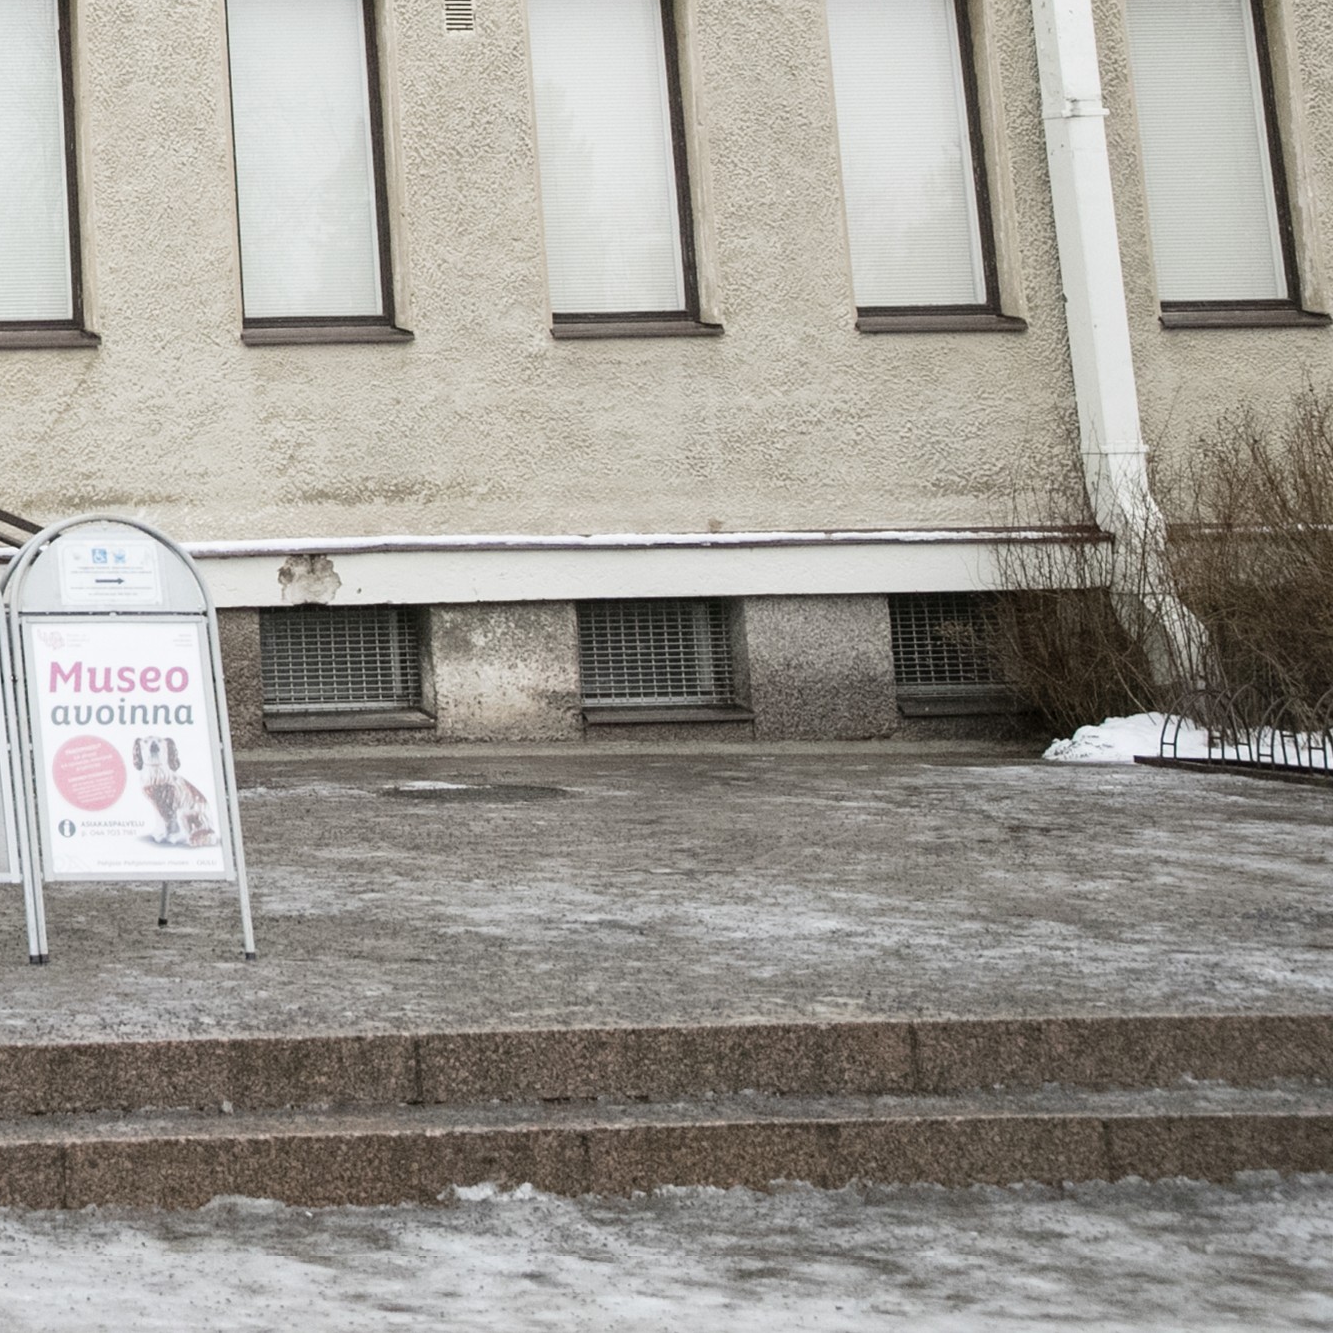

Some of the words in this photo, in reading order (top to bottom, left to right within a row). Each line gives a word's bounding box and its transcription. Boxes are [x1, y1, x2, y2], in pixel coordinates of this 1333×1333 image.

[48, 661, 190, 694] Museo
[51, 697, 194, 726] avoinna
[80, 820, 145, 828] ASIAKASPALVELU
